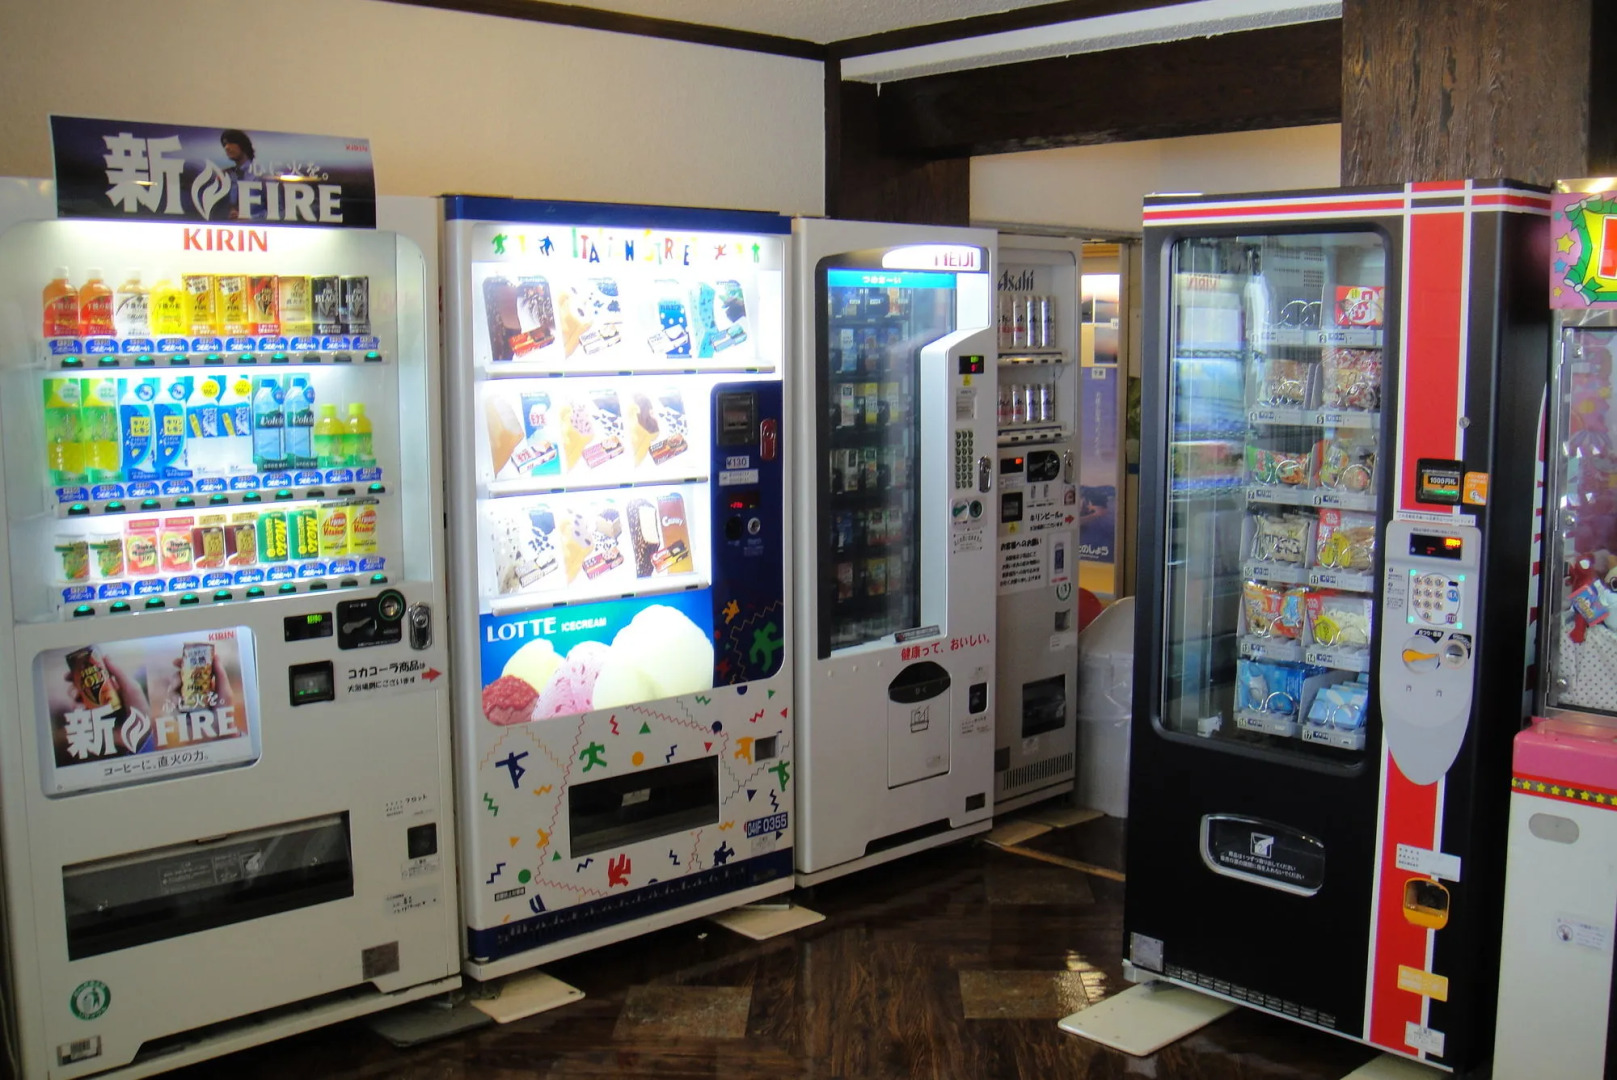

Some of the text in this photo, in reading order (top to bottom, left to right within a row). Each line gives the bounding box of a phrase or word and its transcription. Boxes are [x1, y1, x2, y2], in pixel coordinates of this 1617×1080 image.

[103, 132, 186, 214] 新
[239, 181, 343, 223] FIRE
[184, 228, 268, 252] KIRIN
[998, 269, 1034, 291] Asahi
[208, 630, 235, 641] KIRIN
[486, 617, 607, 643] LOTTE ICECREAM
[901, 633, 990, 661] 健康って、おいしい。
[348, 660, 426, 680] コカコーラ商品は
[162, 692, 226, 713] 心に火を。
[64, 703, 119, 760] 新
[155, 706, 238, 746] FIRE
[103, 750, 209, 776] コーヒーに、直火の力。
[763, 813, 787, 832] 0355
